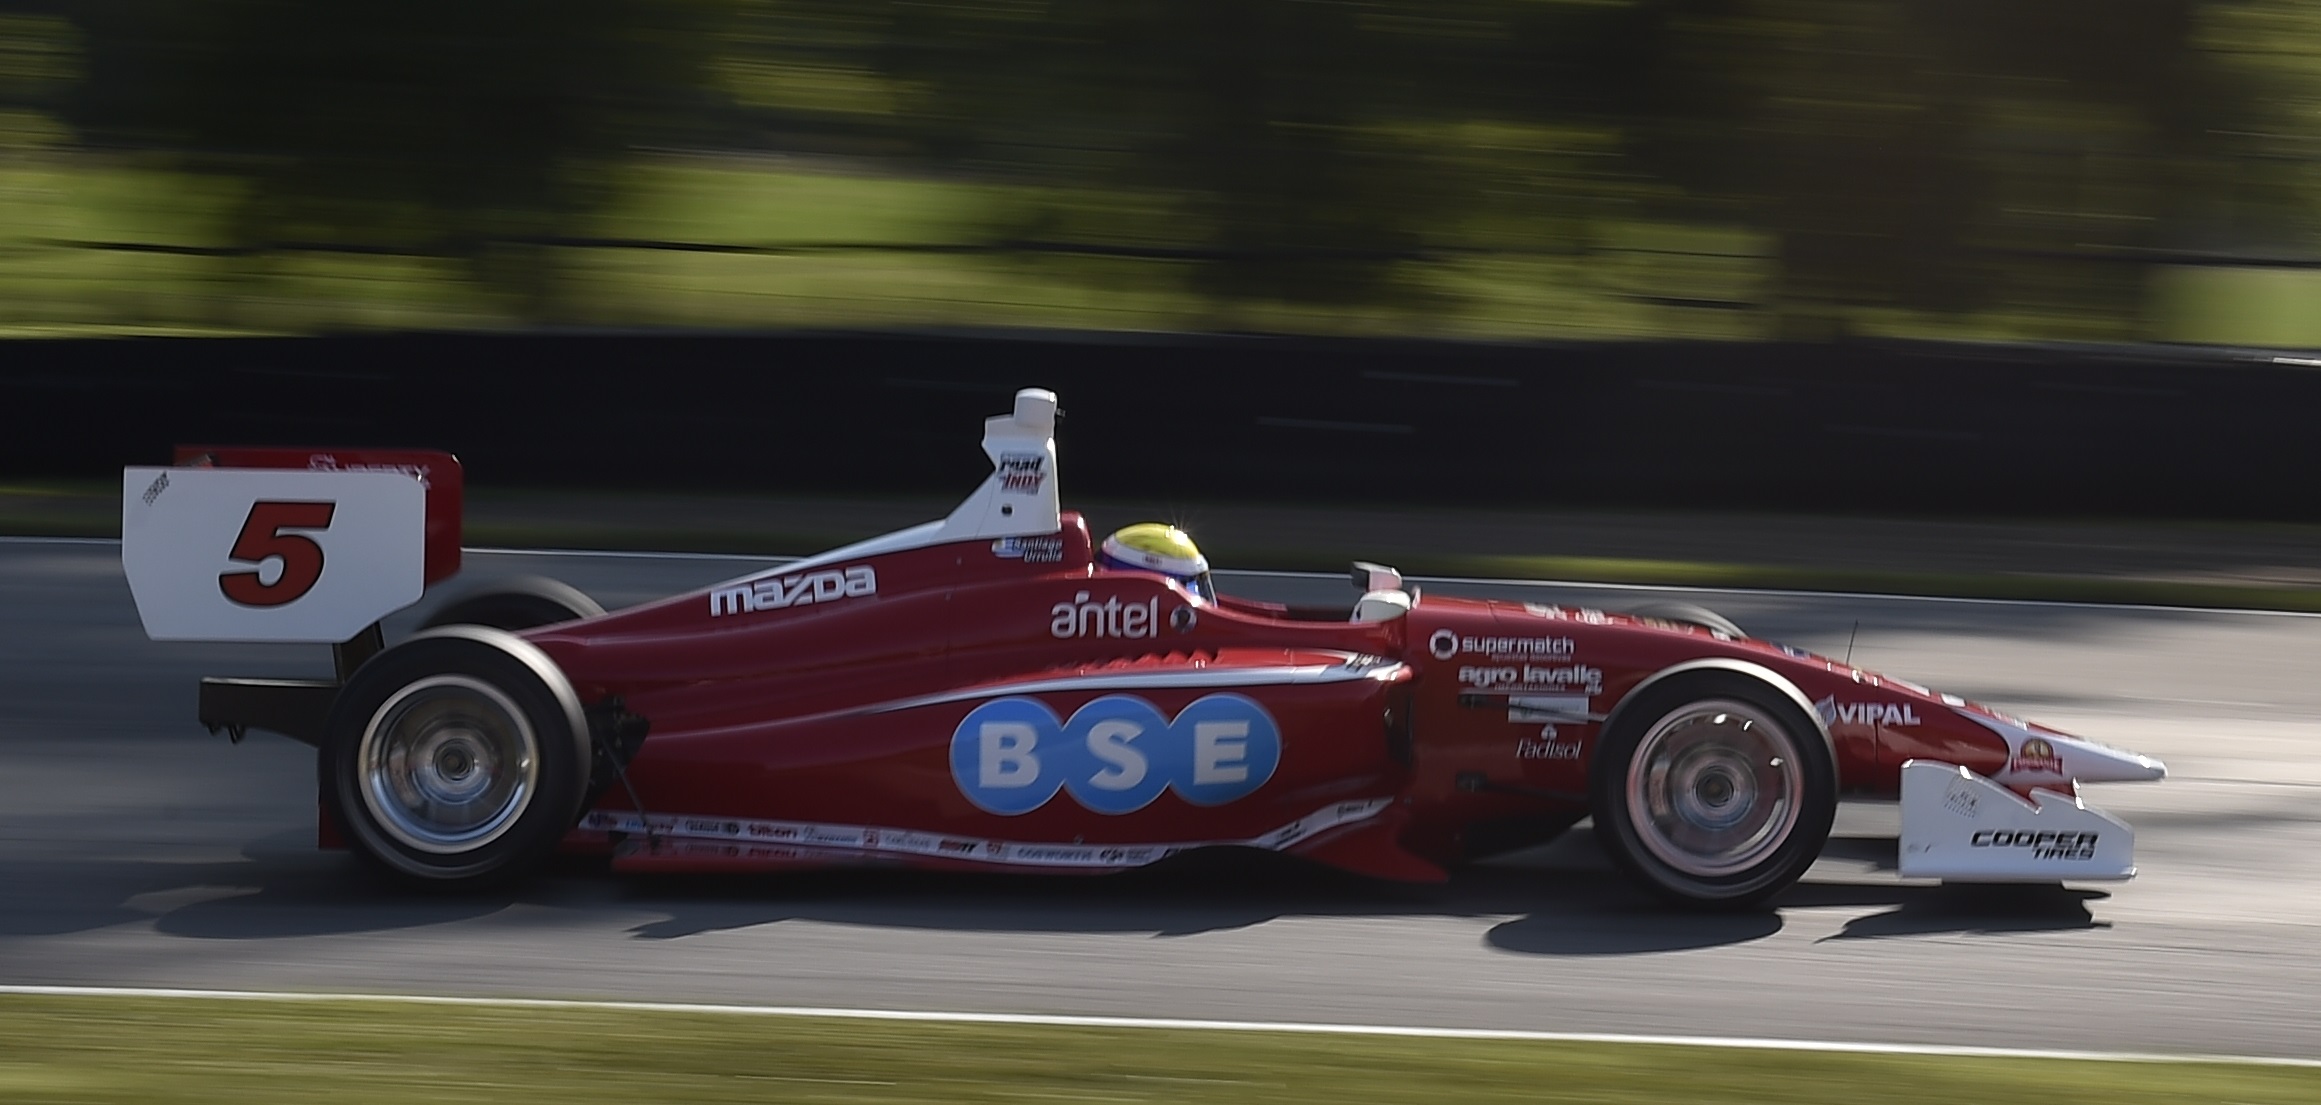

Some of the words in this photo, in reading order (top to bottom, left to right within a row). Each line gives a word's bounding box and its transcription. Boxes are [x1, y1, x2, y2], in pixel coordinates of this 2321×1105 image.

[218, 500, 336, 609] 5
[1050, 590, 1160, 638] antel
[1462, 636, 1575, 656] supermatch
[1458, 665, 1518, 687] agro
[1523, 664, 1602, 684] lavalle
[1838, 703, 1921, 726] VIPAL
[979, 719, 1250, 791] BSE
[1971, 831, 2099, 848] COOPER
[2034, 847, 2095, 860] TIRES
